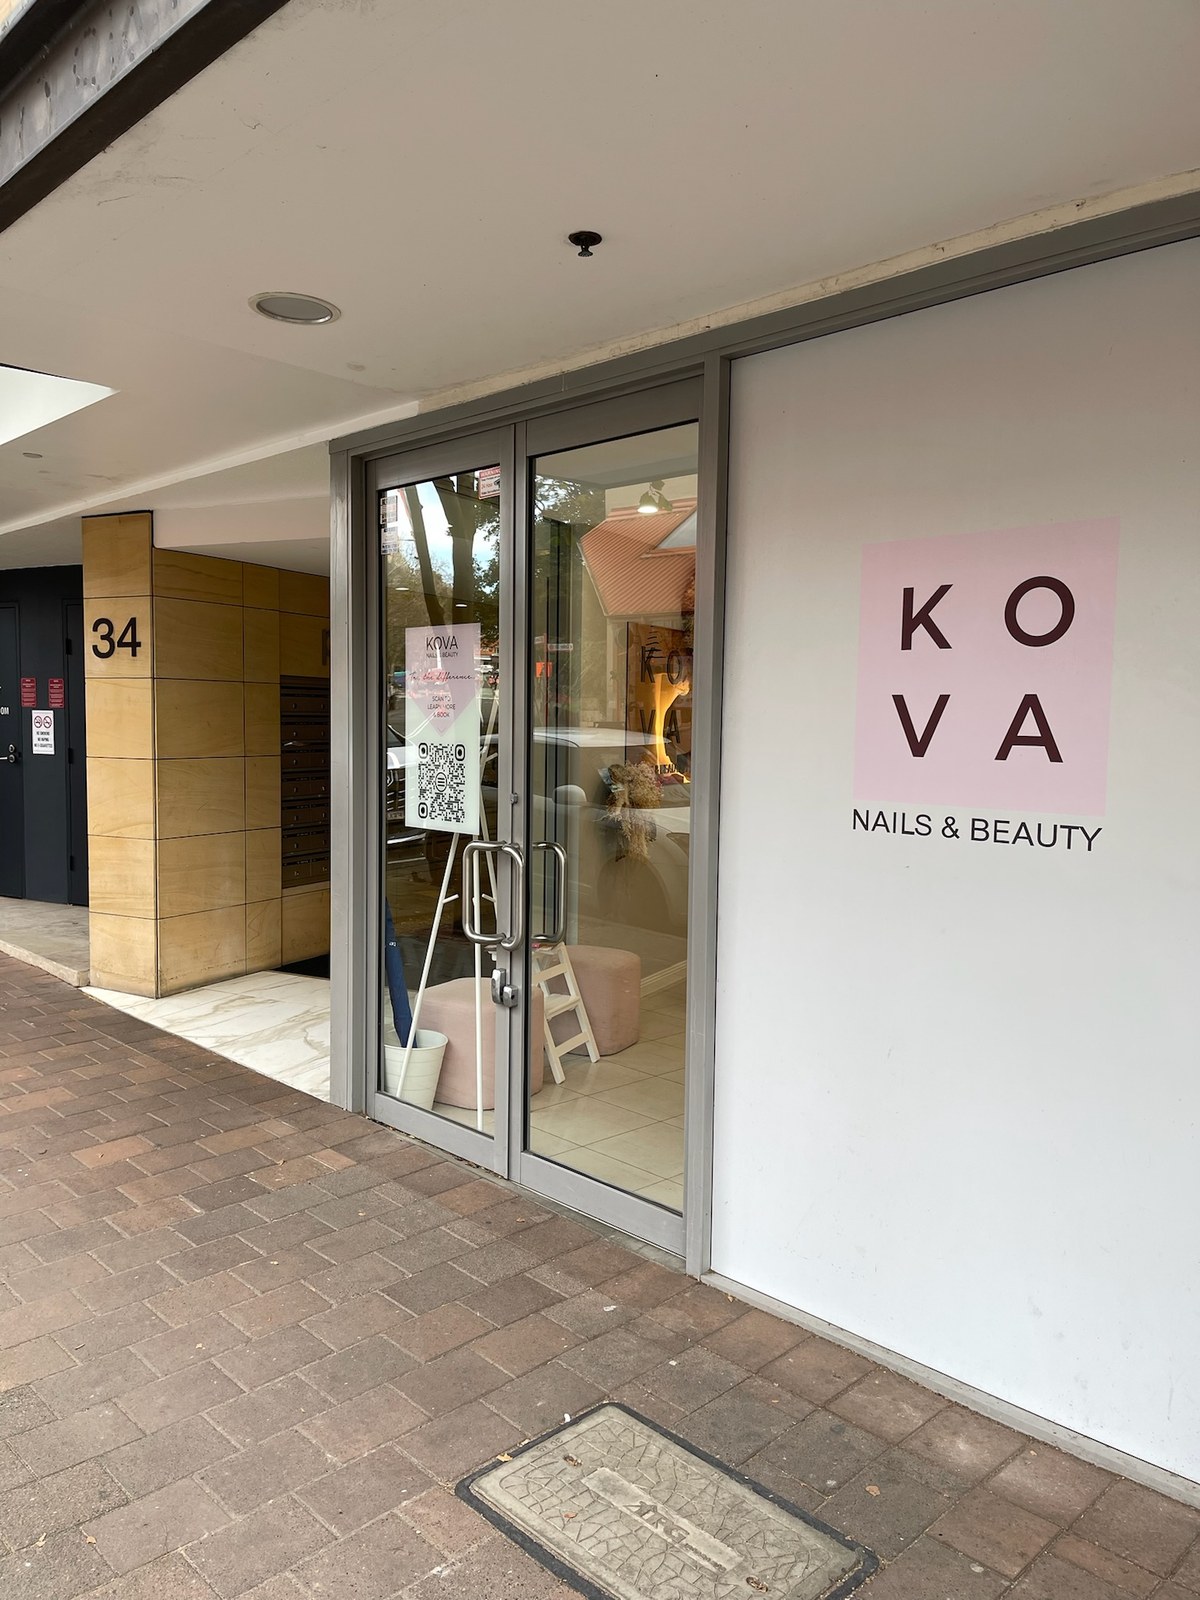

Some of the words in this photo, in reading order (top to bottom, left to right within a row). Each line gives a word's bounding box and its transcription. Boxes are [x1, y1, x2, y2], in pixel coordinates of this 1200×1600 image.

[901, 583, 954, 650] K
[1004, 576, 1075, 647] O
[92, 617, 142, 659] 34
[426, 635, 459, 650] KOVA
[0, 706, 10, 715] OM
[891, 694, 951, 757] V
[994, 694, 1064, 763] A
[852, 808, 932, 836] NAILS
[941, 816, 960, 839] &
[970, 818, 1103, 852] BEAUTY
